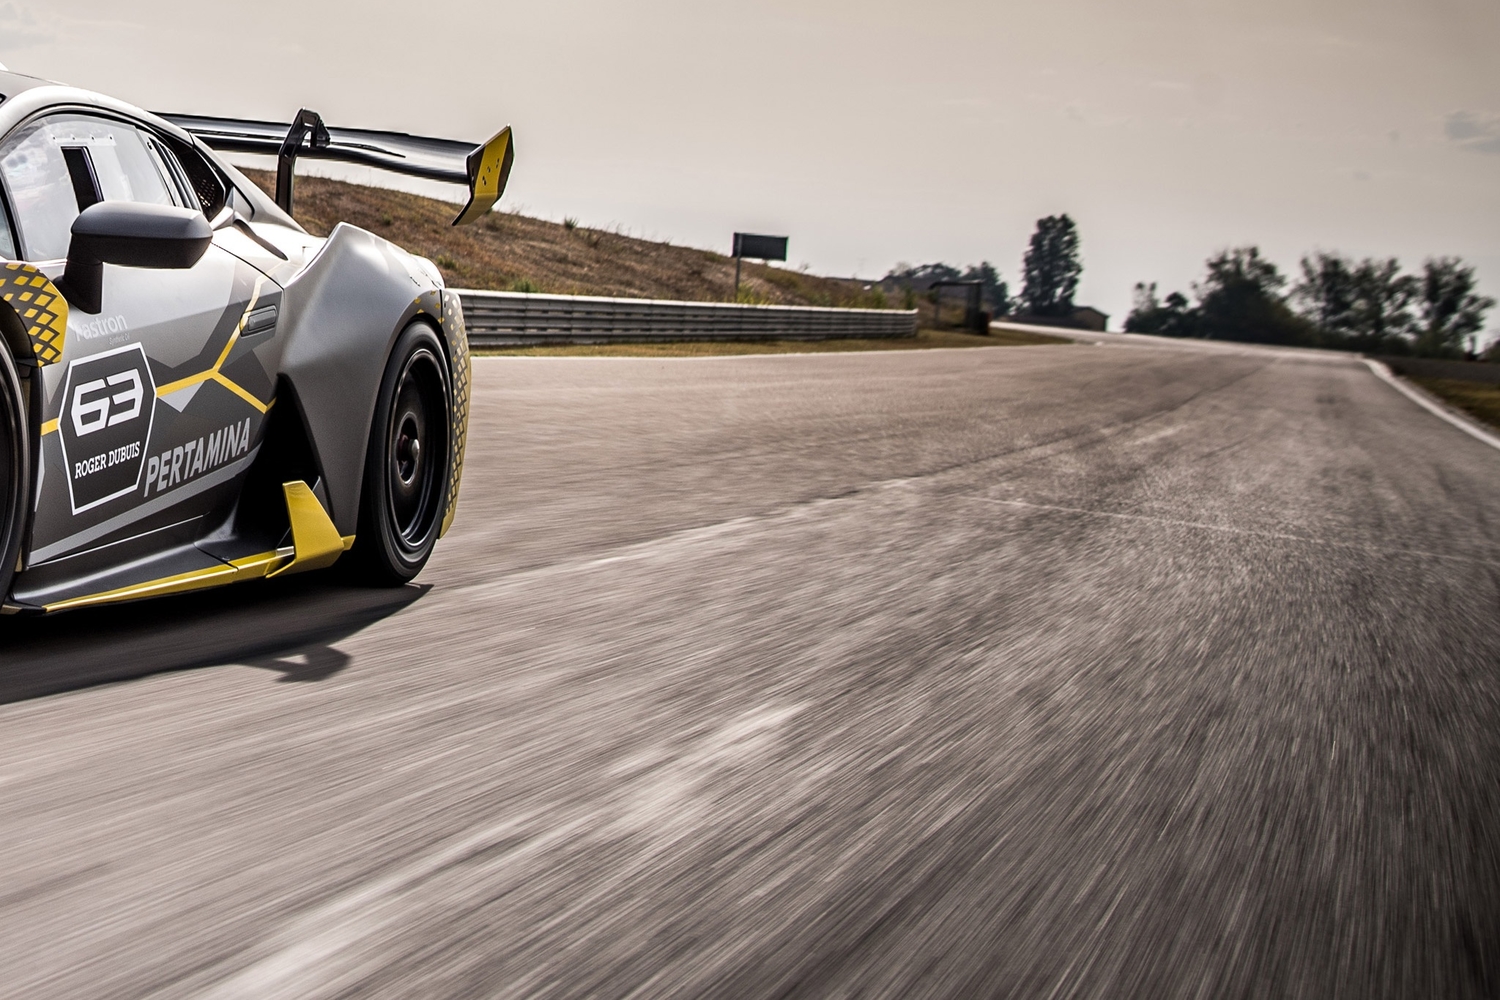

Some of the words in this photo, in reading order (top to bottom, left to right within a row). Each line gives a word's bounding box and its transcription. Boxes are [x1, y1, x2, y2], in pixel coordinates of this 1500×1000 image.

[71, 368, 144, 437] 63
[74, 452, 107, 479] ROGER
[108, 441, 141, 466] DUBUIS
[143, 417, 251, 498] PERTAMINA
